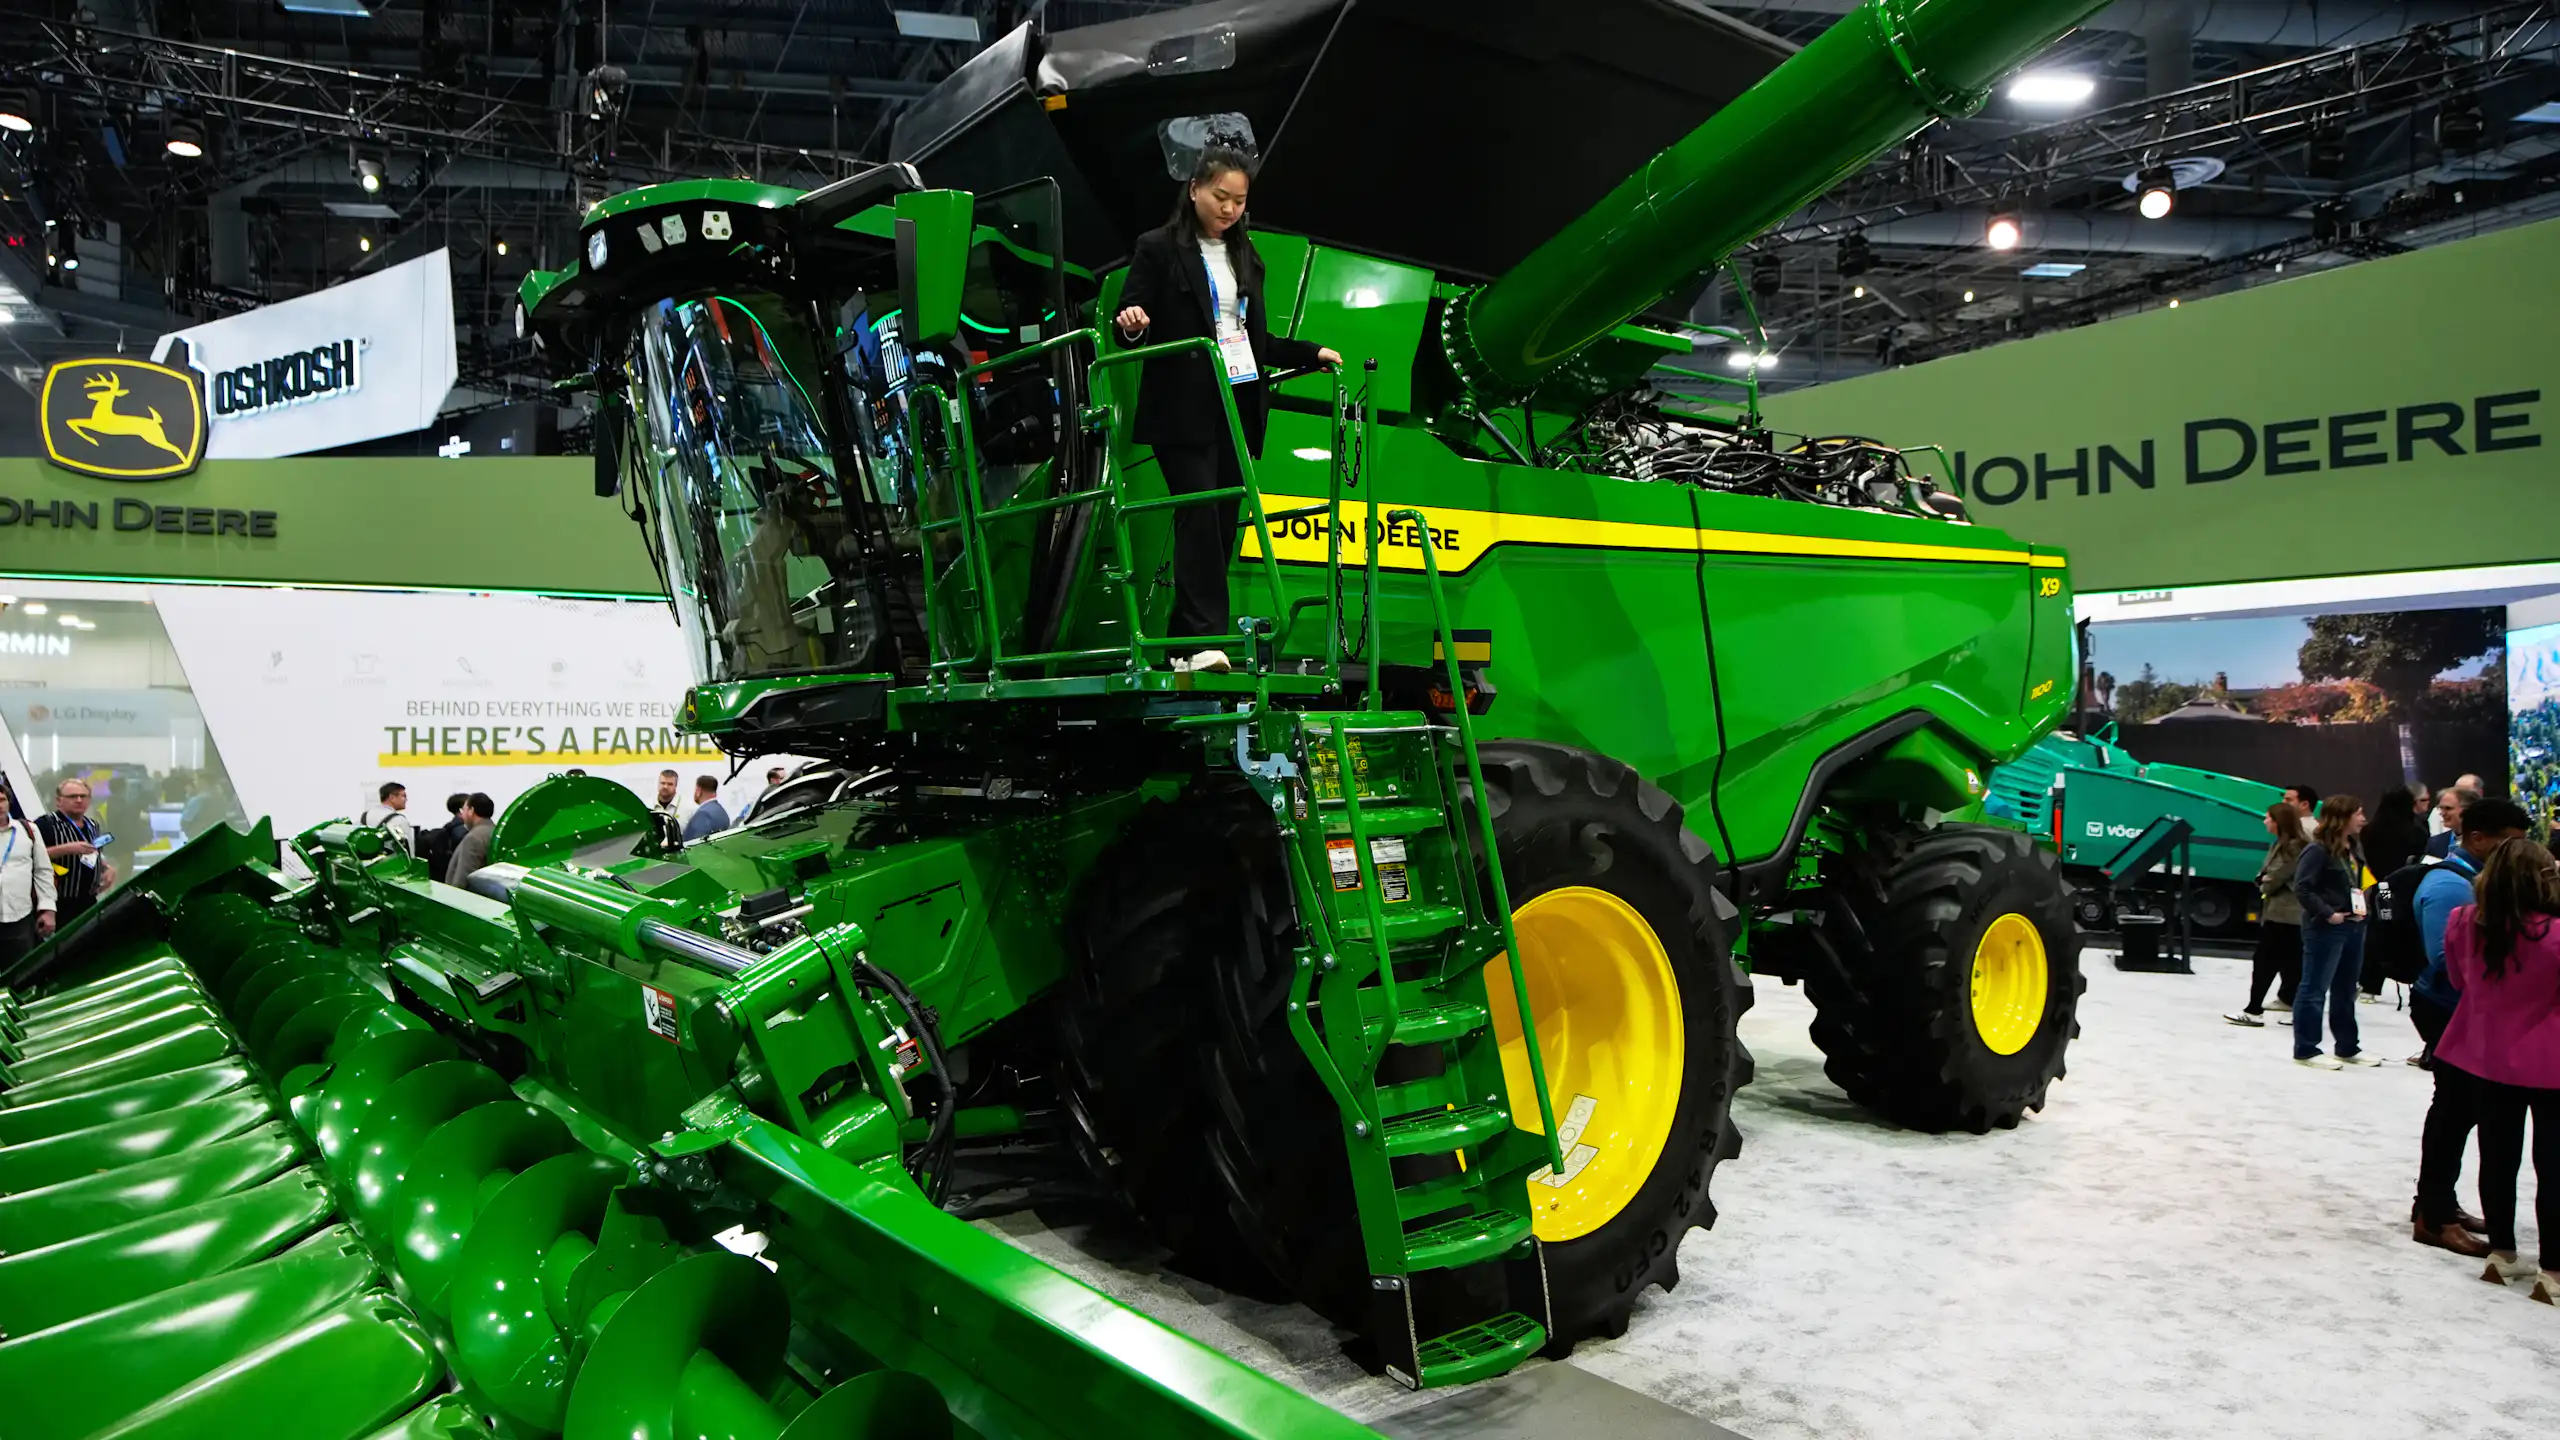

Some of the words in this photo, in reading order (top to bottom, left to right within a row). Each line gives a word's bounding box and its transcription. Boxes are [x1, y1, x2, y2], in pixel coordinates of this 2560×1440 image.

[215, 339, 354, 415] OSHKOSH
[2185, 389, 2542, 485] DEERE
[114, 498, 277, 538] DEERE
[2040, 577, 2060, 597] X9
[53, 706, 77, 720] LG
[407, 700, 480, 717] BEHIND
[487, 701, 601, 717] EVERYTHING
[606, 702, 634, 717] WE
[640, 702, 677, 718] RELY
[557, 727, 581, 755] A
[593, 726, 723, 755] FARME
